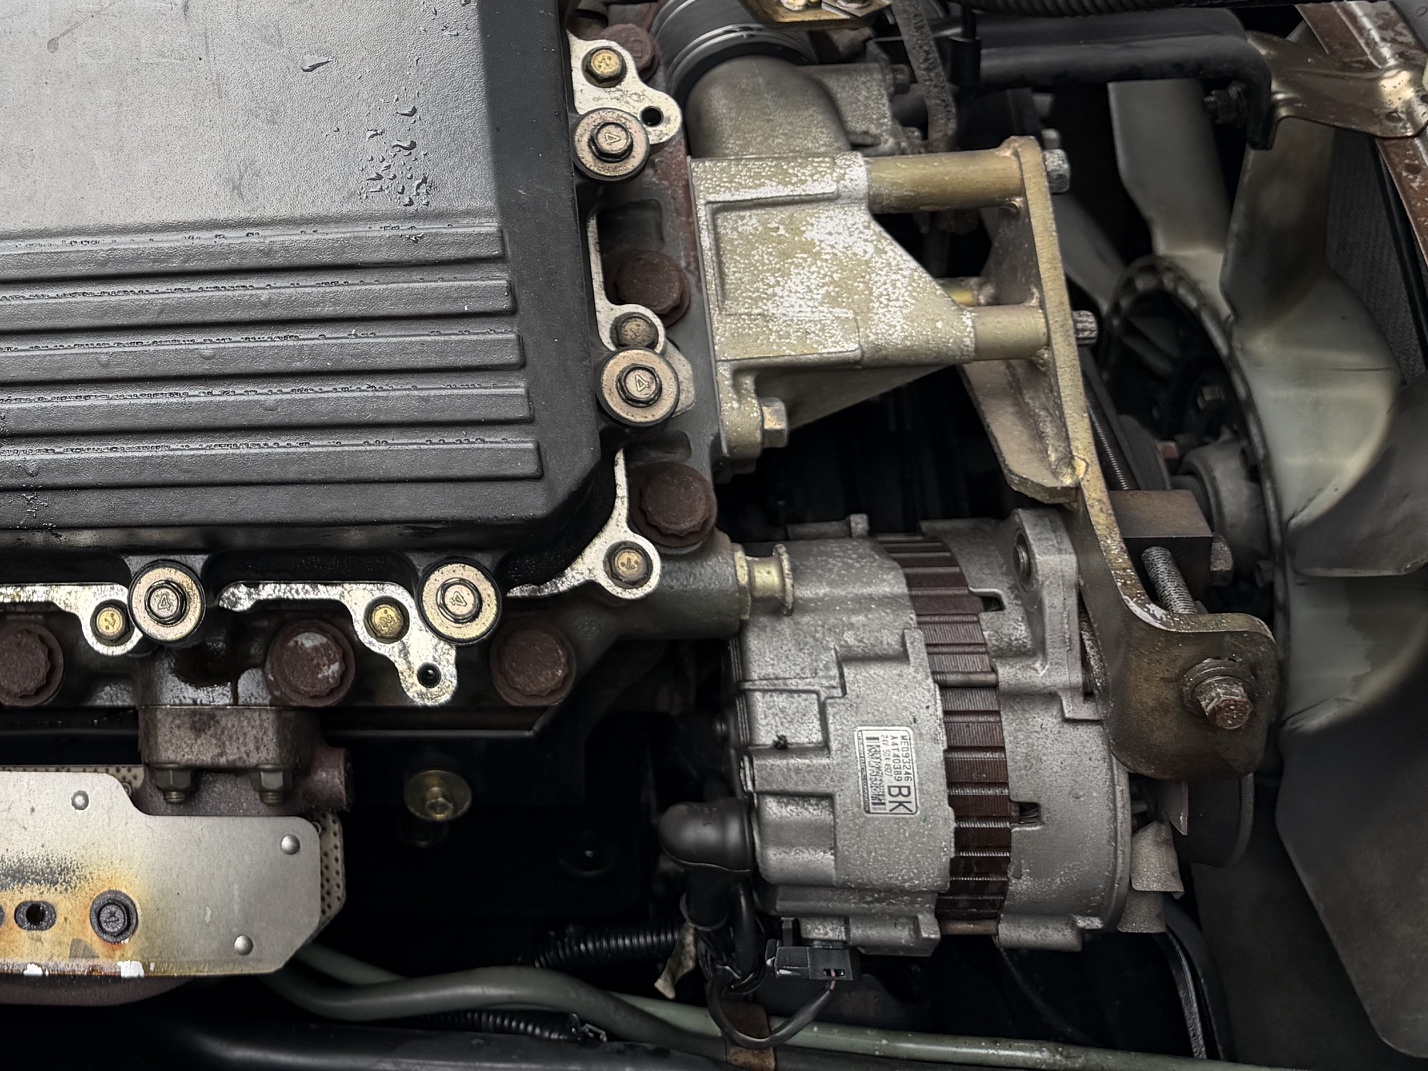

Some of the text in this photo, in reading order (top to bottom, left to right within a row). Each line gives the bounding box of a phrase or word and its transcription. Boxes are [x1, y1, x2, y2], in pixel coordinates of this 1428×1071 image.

[635, 374, 650, 392] 4
[157, 593, 172, 610] 4
[890, 735, 902, 782] A4T40389
[900, 735, 912, 782] ME093246
[887, 785, 913, 812] BK
